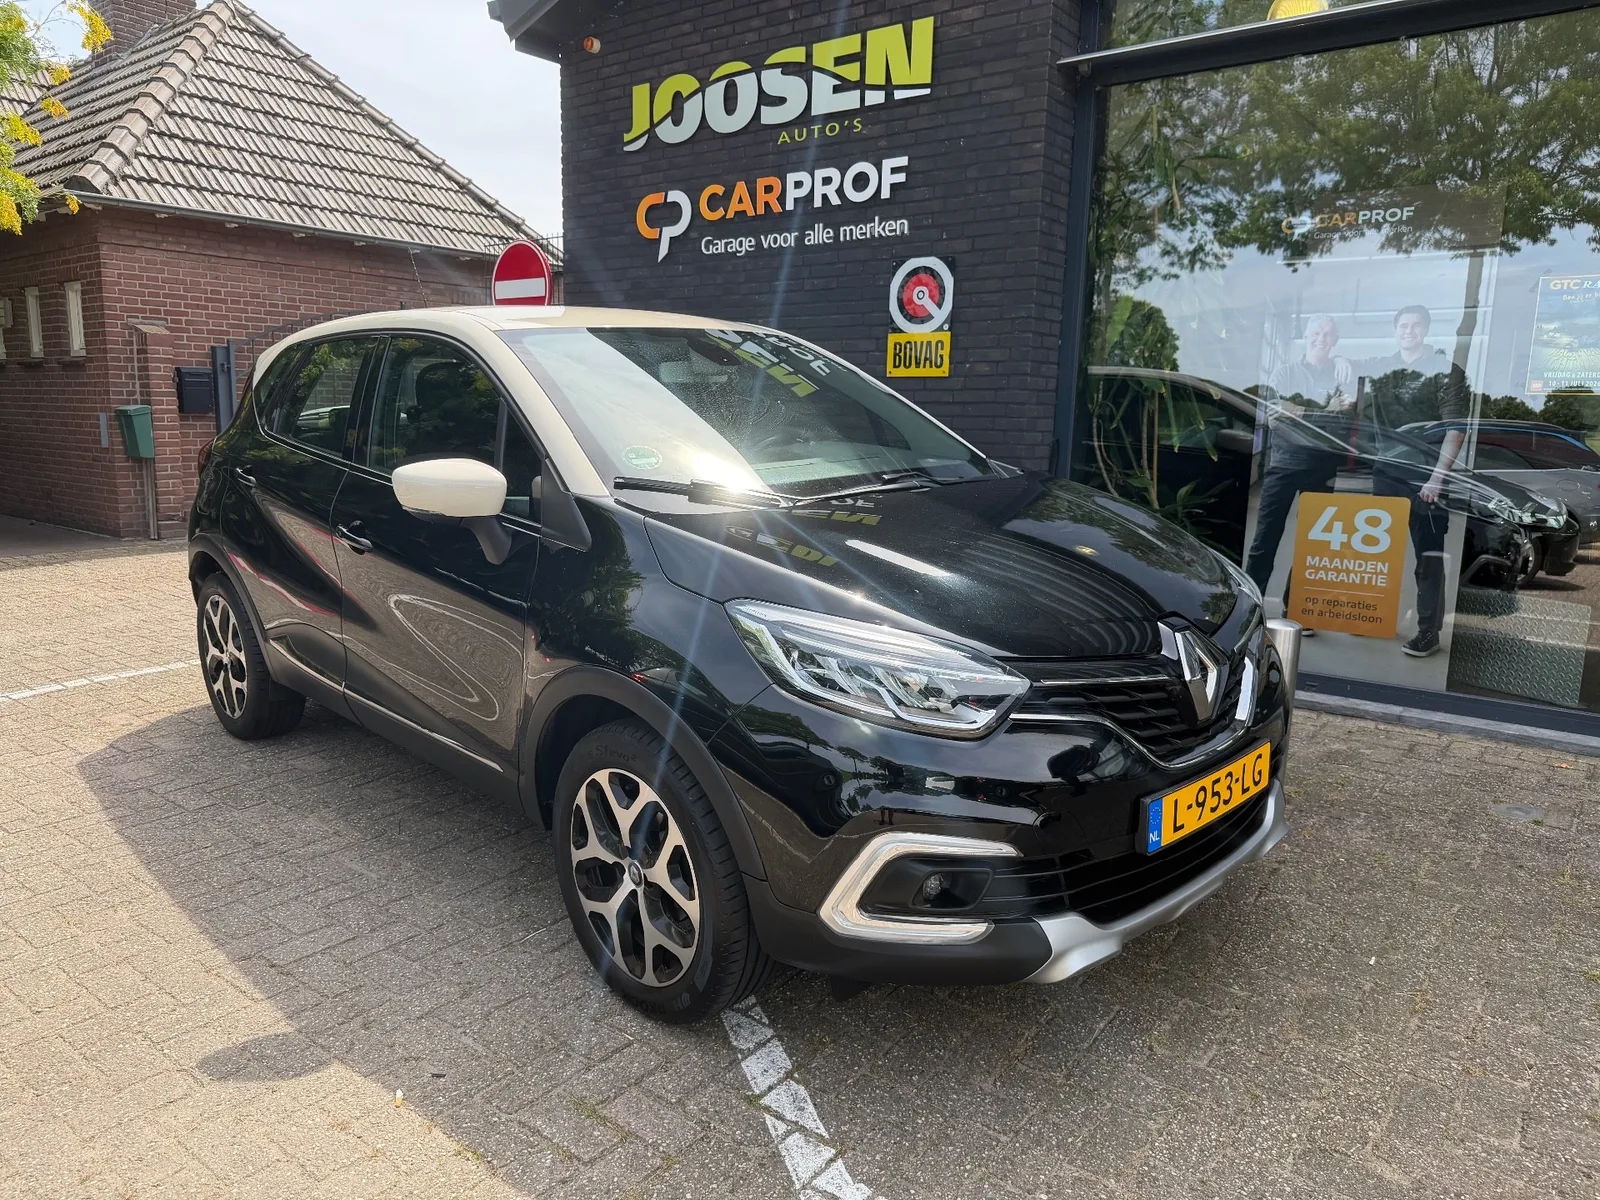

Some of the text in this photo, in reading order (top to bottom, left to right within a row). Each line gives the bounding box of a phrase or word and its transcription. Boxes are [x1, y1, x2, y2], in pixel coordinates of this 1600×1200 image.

[623, 16, 934, 151] JOOSEN
[777, 118, 863, 145] AUTO'S
[699, 156, 909, 221] CARPROF
[1316, 206, 1415, 228] CARPROF
[701, 216, 909, 256] Garage voor alle merken
[1550, 279, 1582, 290] GTC
[892, 339, 945, 370] BOVAG
[1308, 506, 1393, 554] 48
[1306, 555, 1389, 574] MAANDEN
[1305, 569, 1387, 587] GARANTIE
[1301, 607, 1383, 624] en arbeidsloon
[1305, 596, 1378, 611] op reparaties
[1173, 753, 1263, 833] L-953-LG
[1149, 831, 1160, 843] NL
